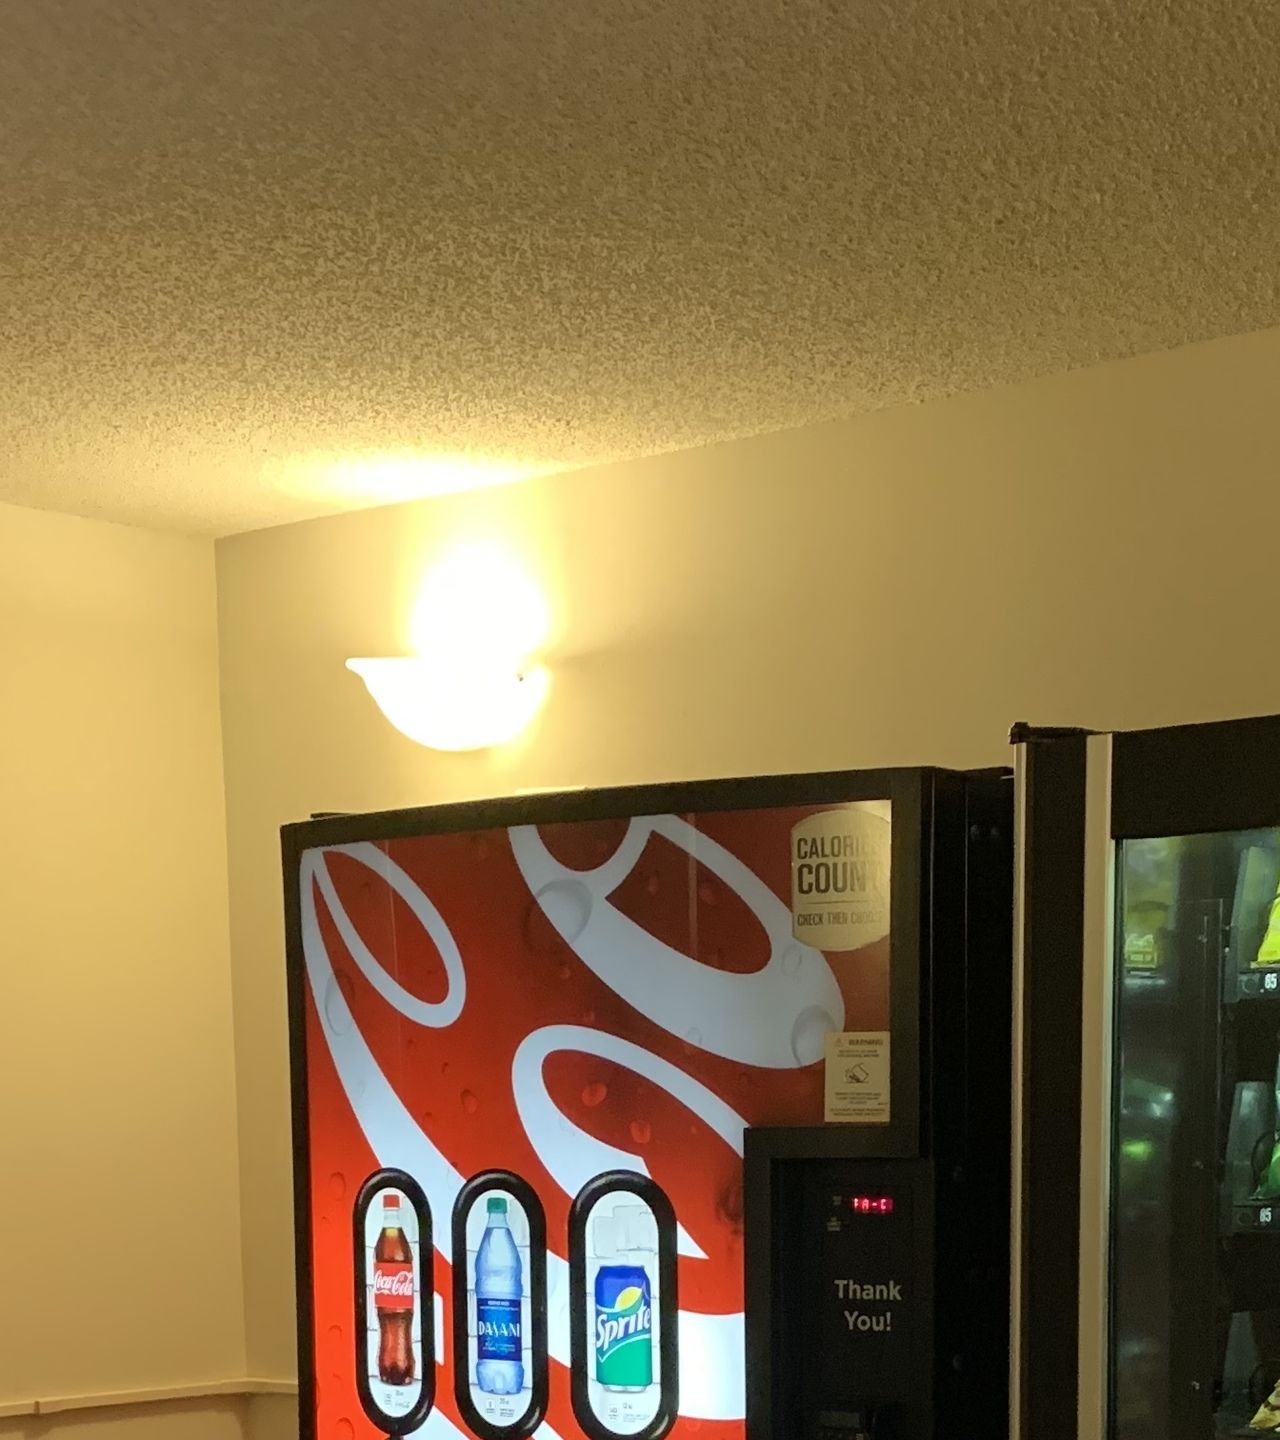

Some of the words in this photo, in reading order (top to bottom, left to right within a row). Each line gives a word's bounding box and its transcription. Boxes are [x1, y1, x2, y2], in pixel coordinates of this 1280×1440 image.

[797, 912, 824, 927] CHECK
[834, 1279, 902, 1300] Thank
[478, 1320, 521, 1338] DASANI
[595, 1302, 652, 1350] Sprite
[844, 1311, 891, 1332] You!
